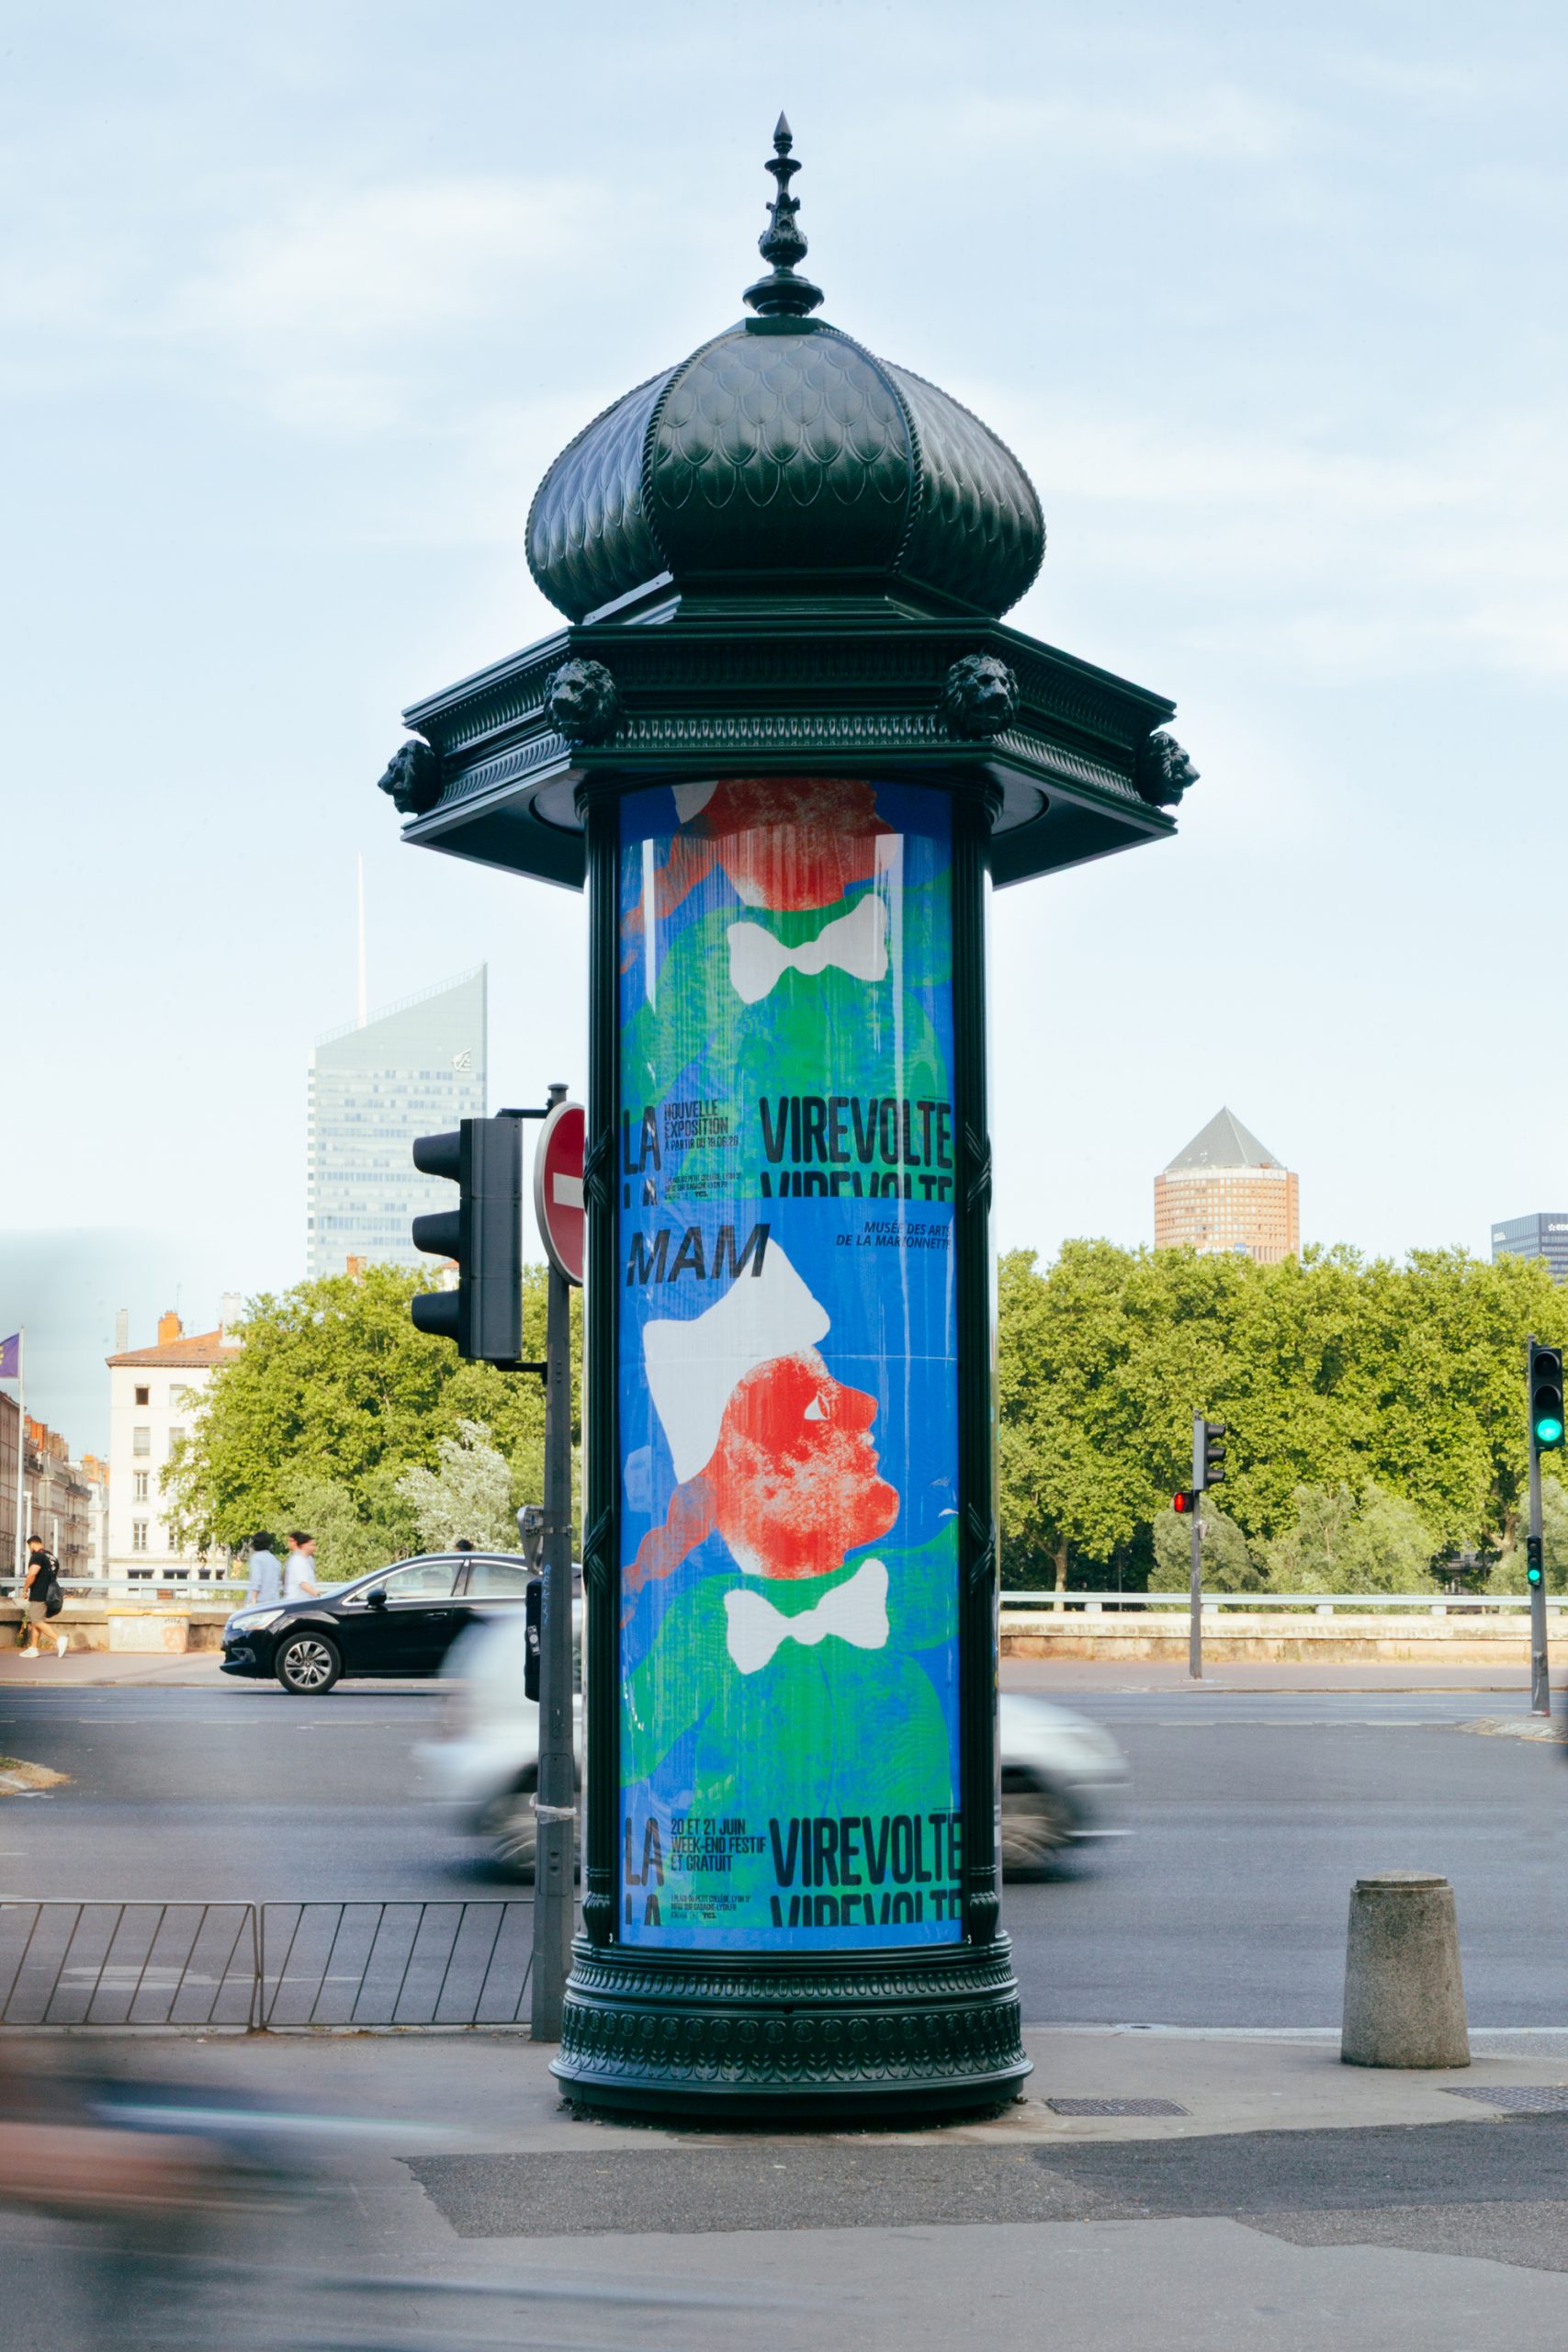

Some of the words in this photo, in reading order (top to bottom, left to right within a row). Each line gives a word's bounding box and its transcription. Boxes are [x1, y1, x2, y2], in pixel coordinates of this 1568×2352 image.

[664, 1099, 719, 1121] NOUVELLE
[623, 1105, 661, 1176] LA
[759, 1096, 953, 1169] VIREVOLTE
[664, 1116, 728, 1140] EXPOSITION
[671, 1138, 695, 1151] PARTIR
[864, 1220, 904, 1233] MUSÉE
[907, 1223, 927, 1235] DES
[928, 1225, 952, 1237] ARTS
[836, 1234, 852, 1246] DE
[856, 1235, 872, 1247] LA
[626, 1223, 771, 1286] MAM
[671, 1818, 684, 1836] 20
[687, 1818, 700, 1836] ET
[704, 1818, 716, 1836] 21
[719, 1818, 746, 1836] JUIN
[625, 1816, 664, 1886] LA
[769, 1814, 962, 1887] VIREVOLTE
[671, 1837, 726, 1853] WEEK-END
[729, 1837, 766, 1853] FESTIF
[671, 1855, 683, 1871] ET
[686, 1854, 733, 1871] GRATUIT
